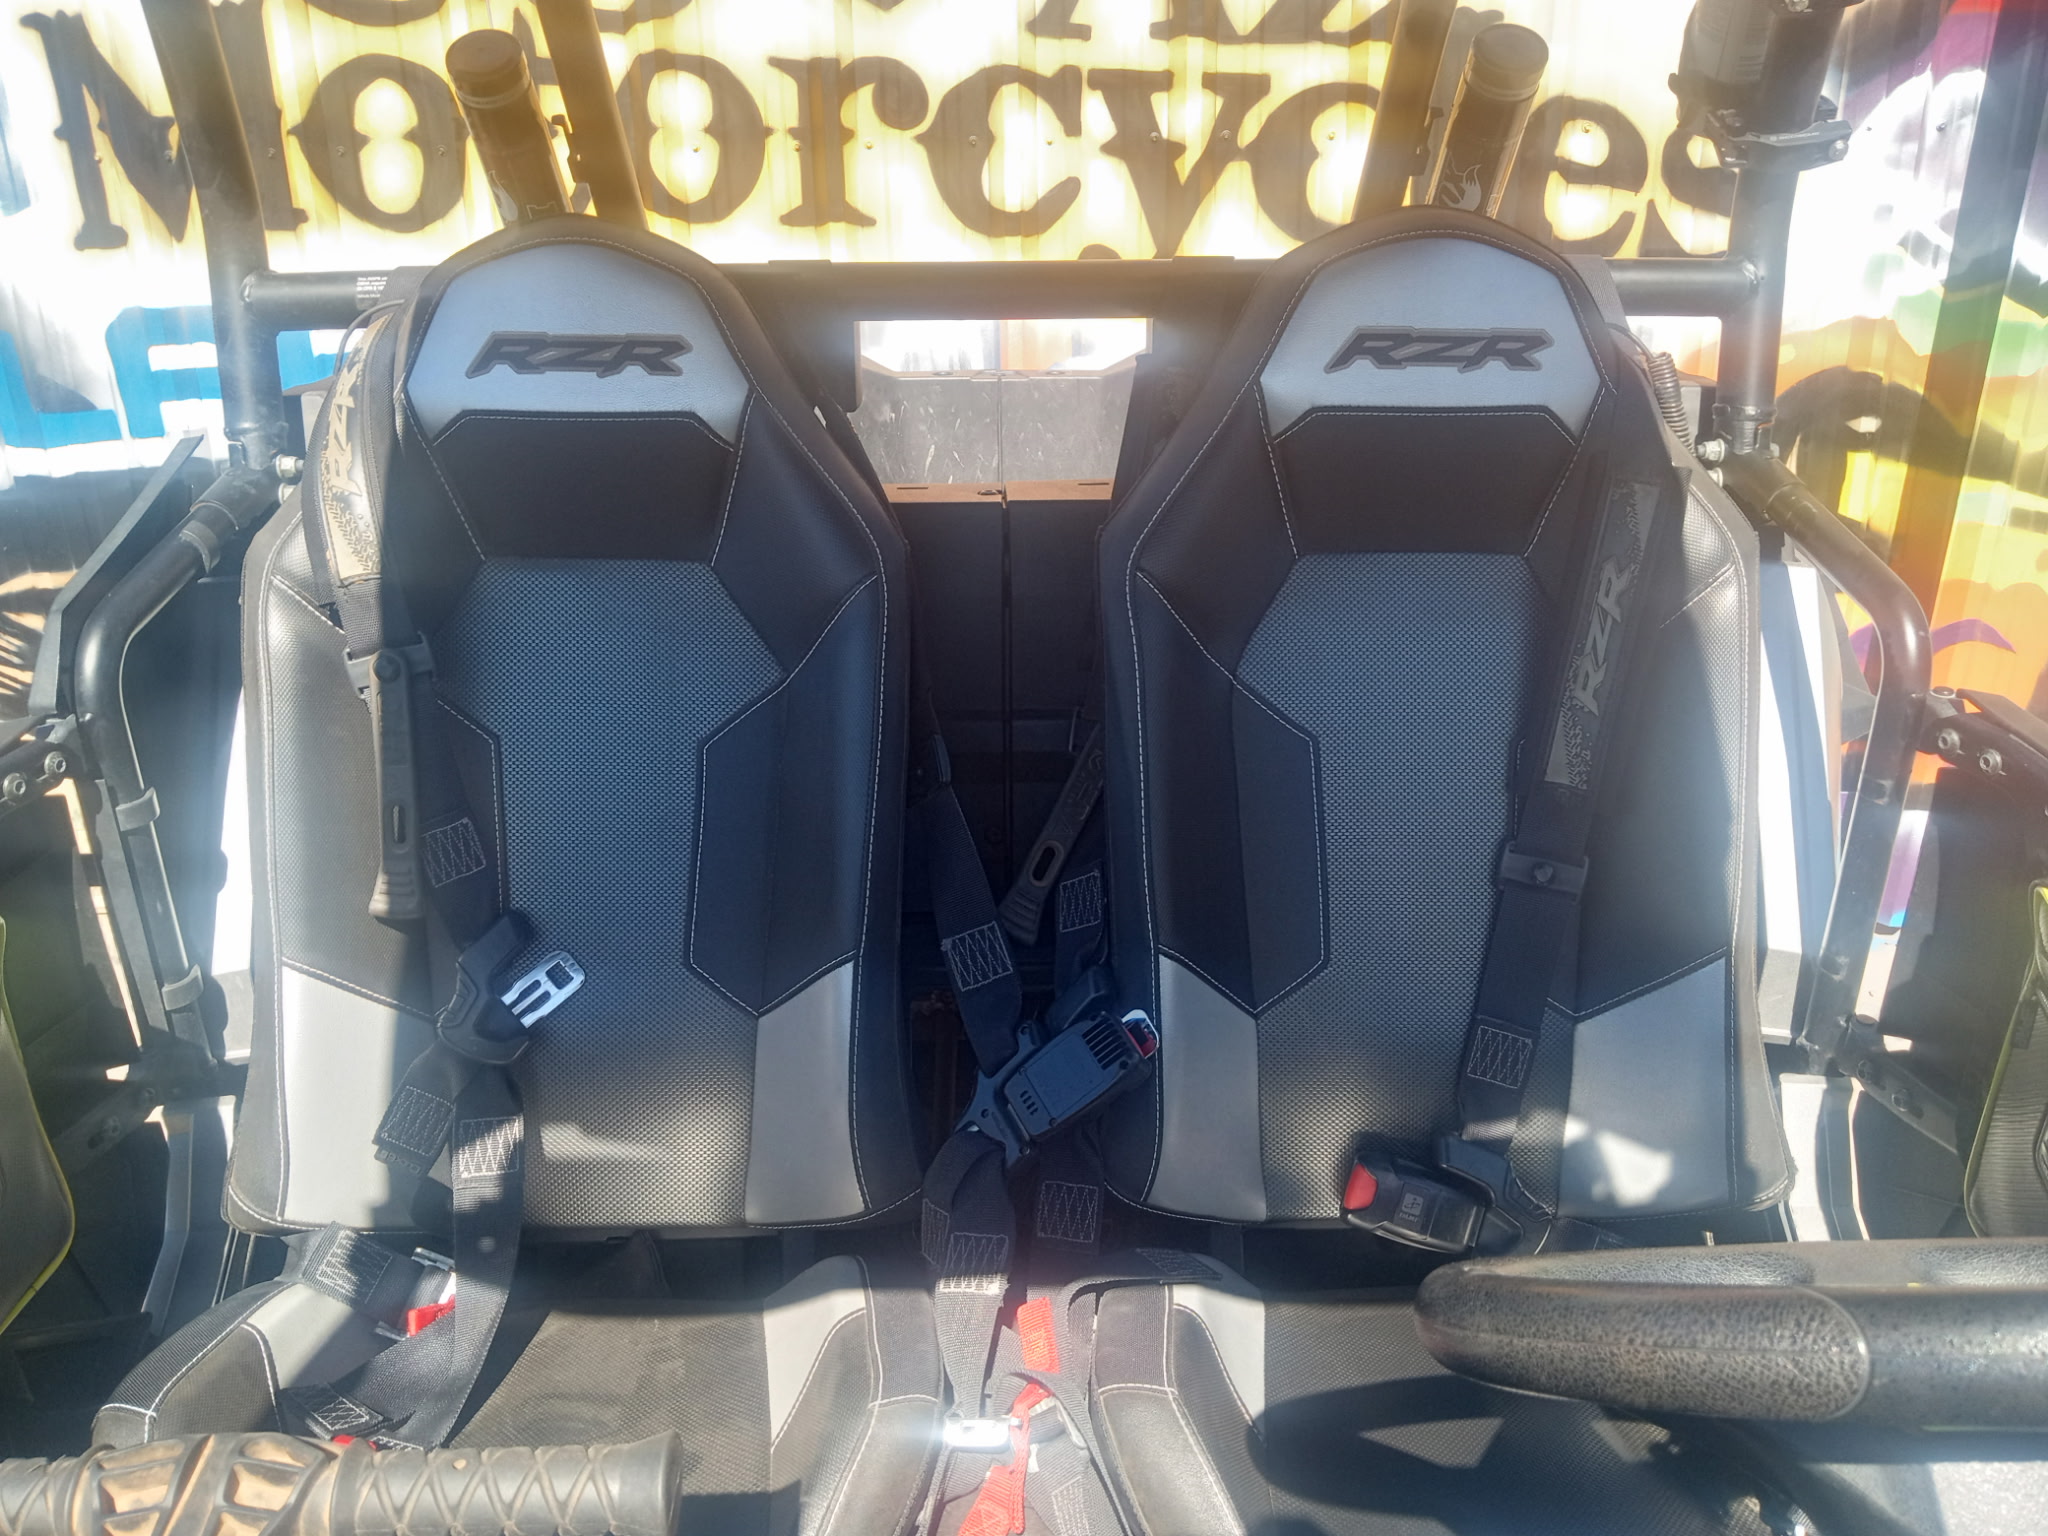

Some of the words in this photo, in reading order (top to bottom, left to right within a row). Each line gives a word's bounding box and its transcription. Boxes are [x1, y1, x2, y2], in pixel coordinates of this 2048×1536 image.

[466, 331, 693, 379] RZR
[1324, 326, 1554, 374] RZR
[327, 362, 363, 497] RZR
[1573, 556, 1635, 716] RZR
